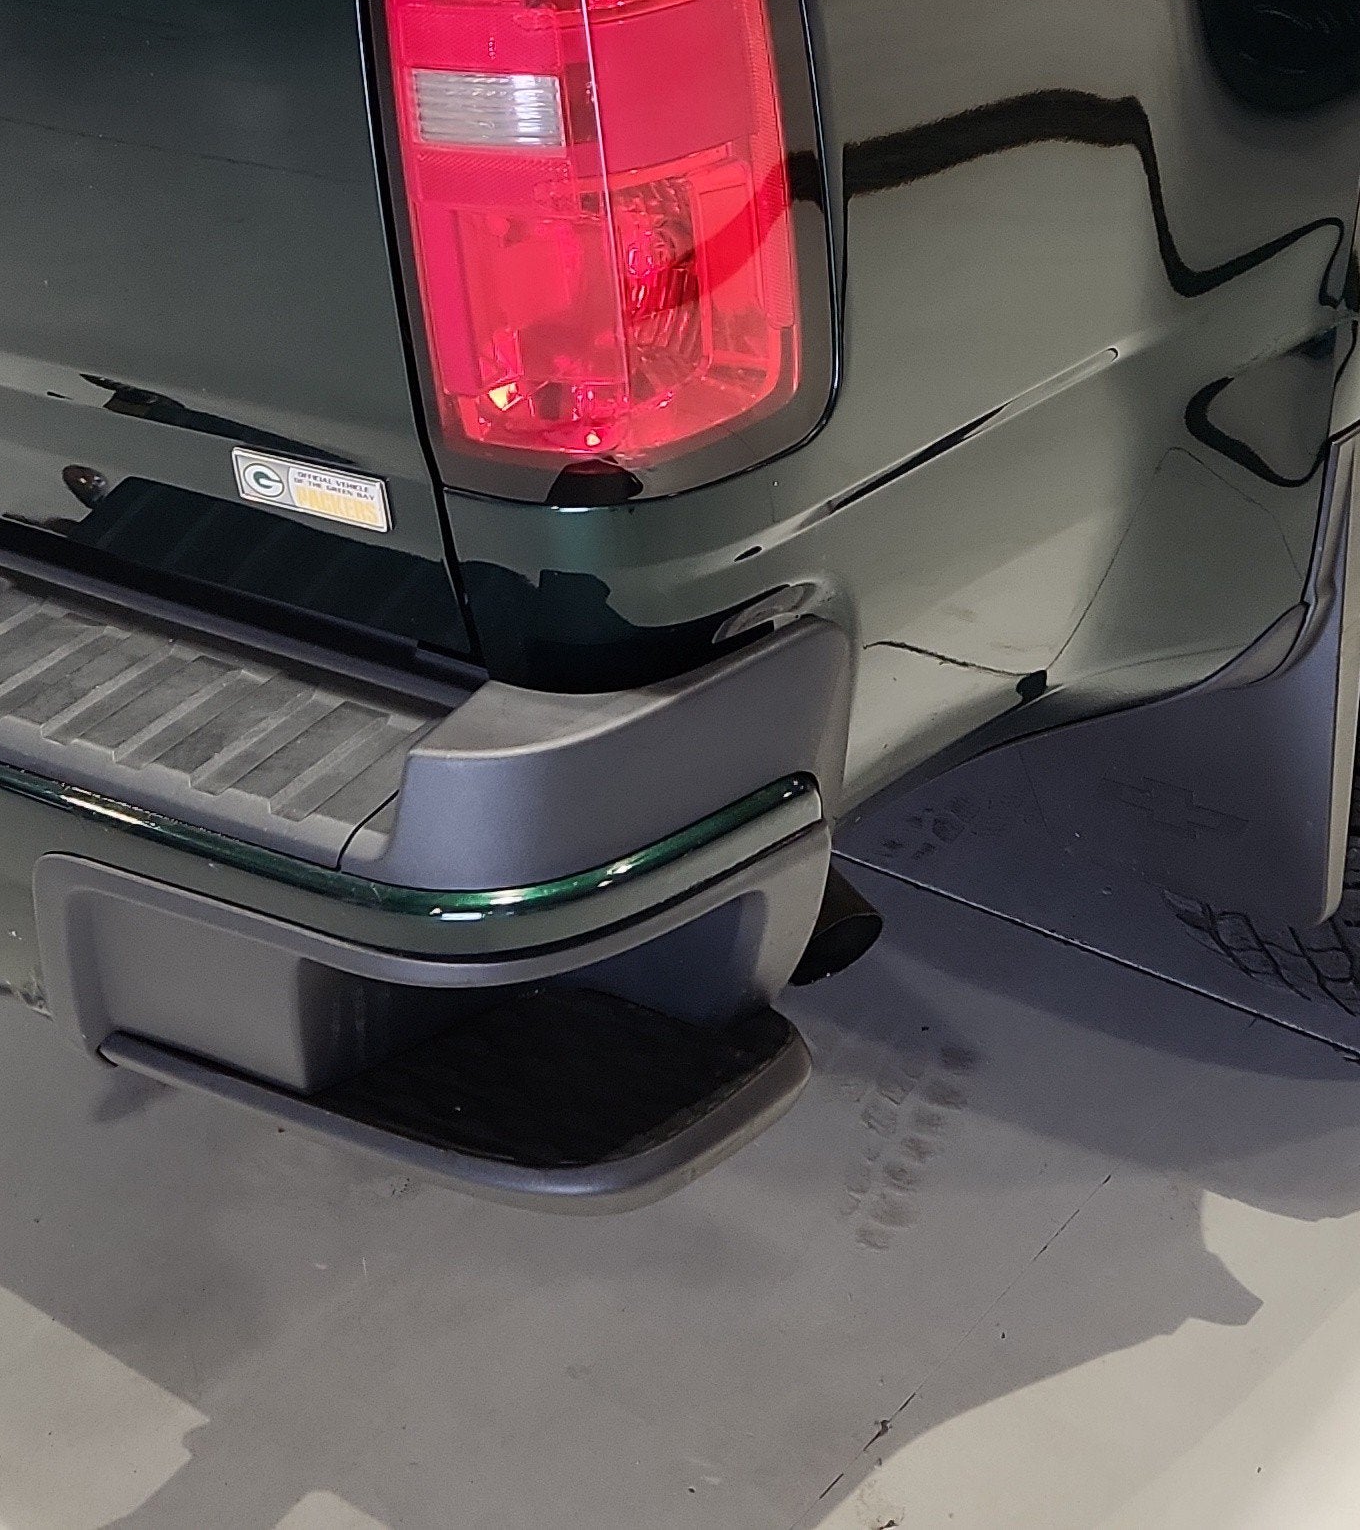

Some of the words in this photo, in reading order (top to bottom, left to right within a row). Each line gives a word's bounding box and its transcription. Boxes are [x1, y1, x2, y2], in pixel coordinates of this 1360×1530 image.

[293, 476, 304, 484] OF
[308, 480, 322, 489] THE
[326, 485, 354, 497] GREEN
[356, 492, 375, 501] BAY
[297, 471, 332, 485] OFFICIAL
[335, 480, 369, 494] VEHICLE
